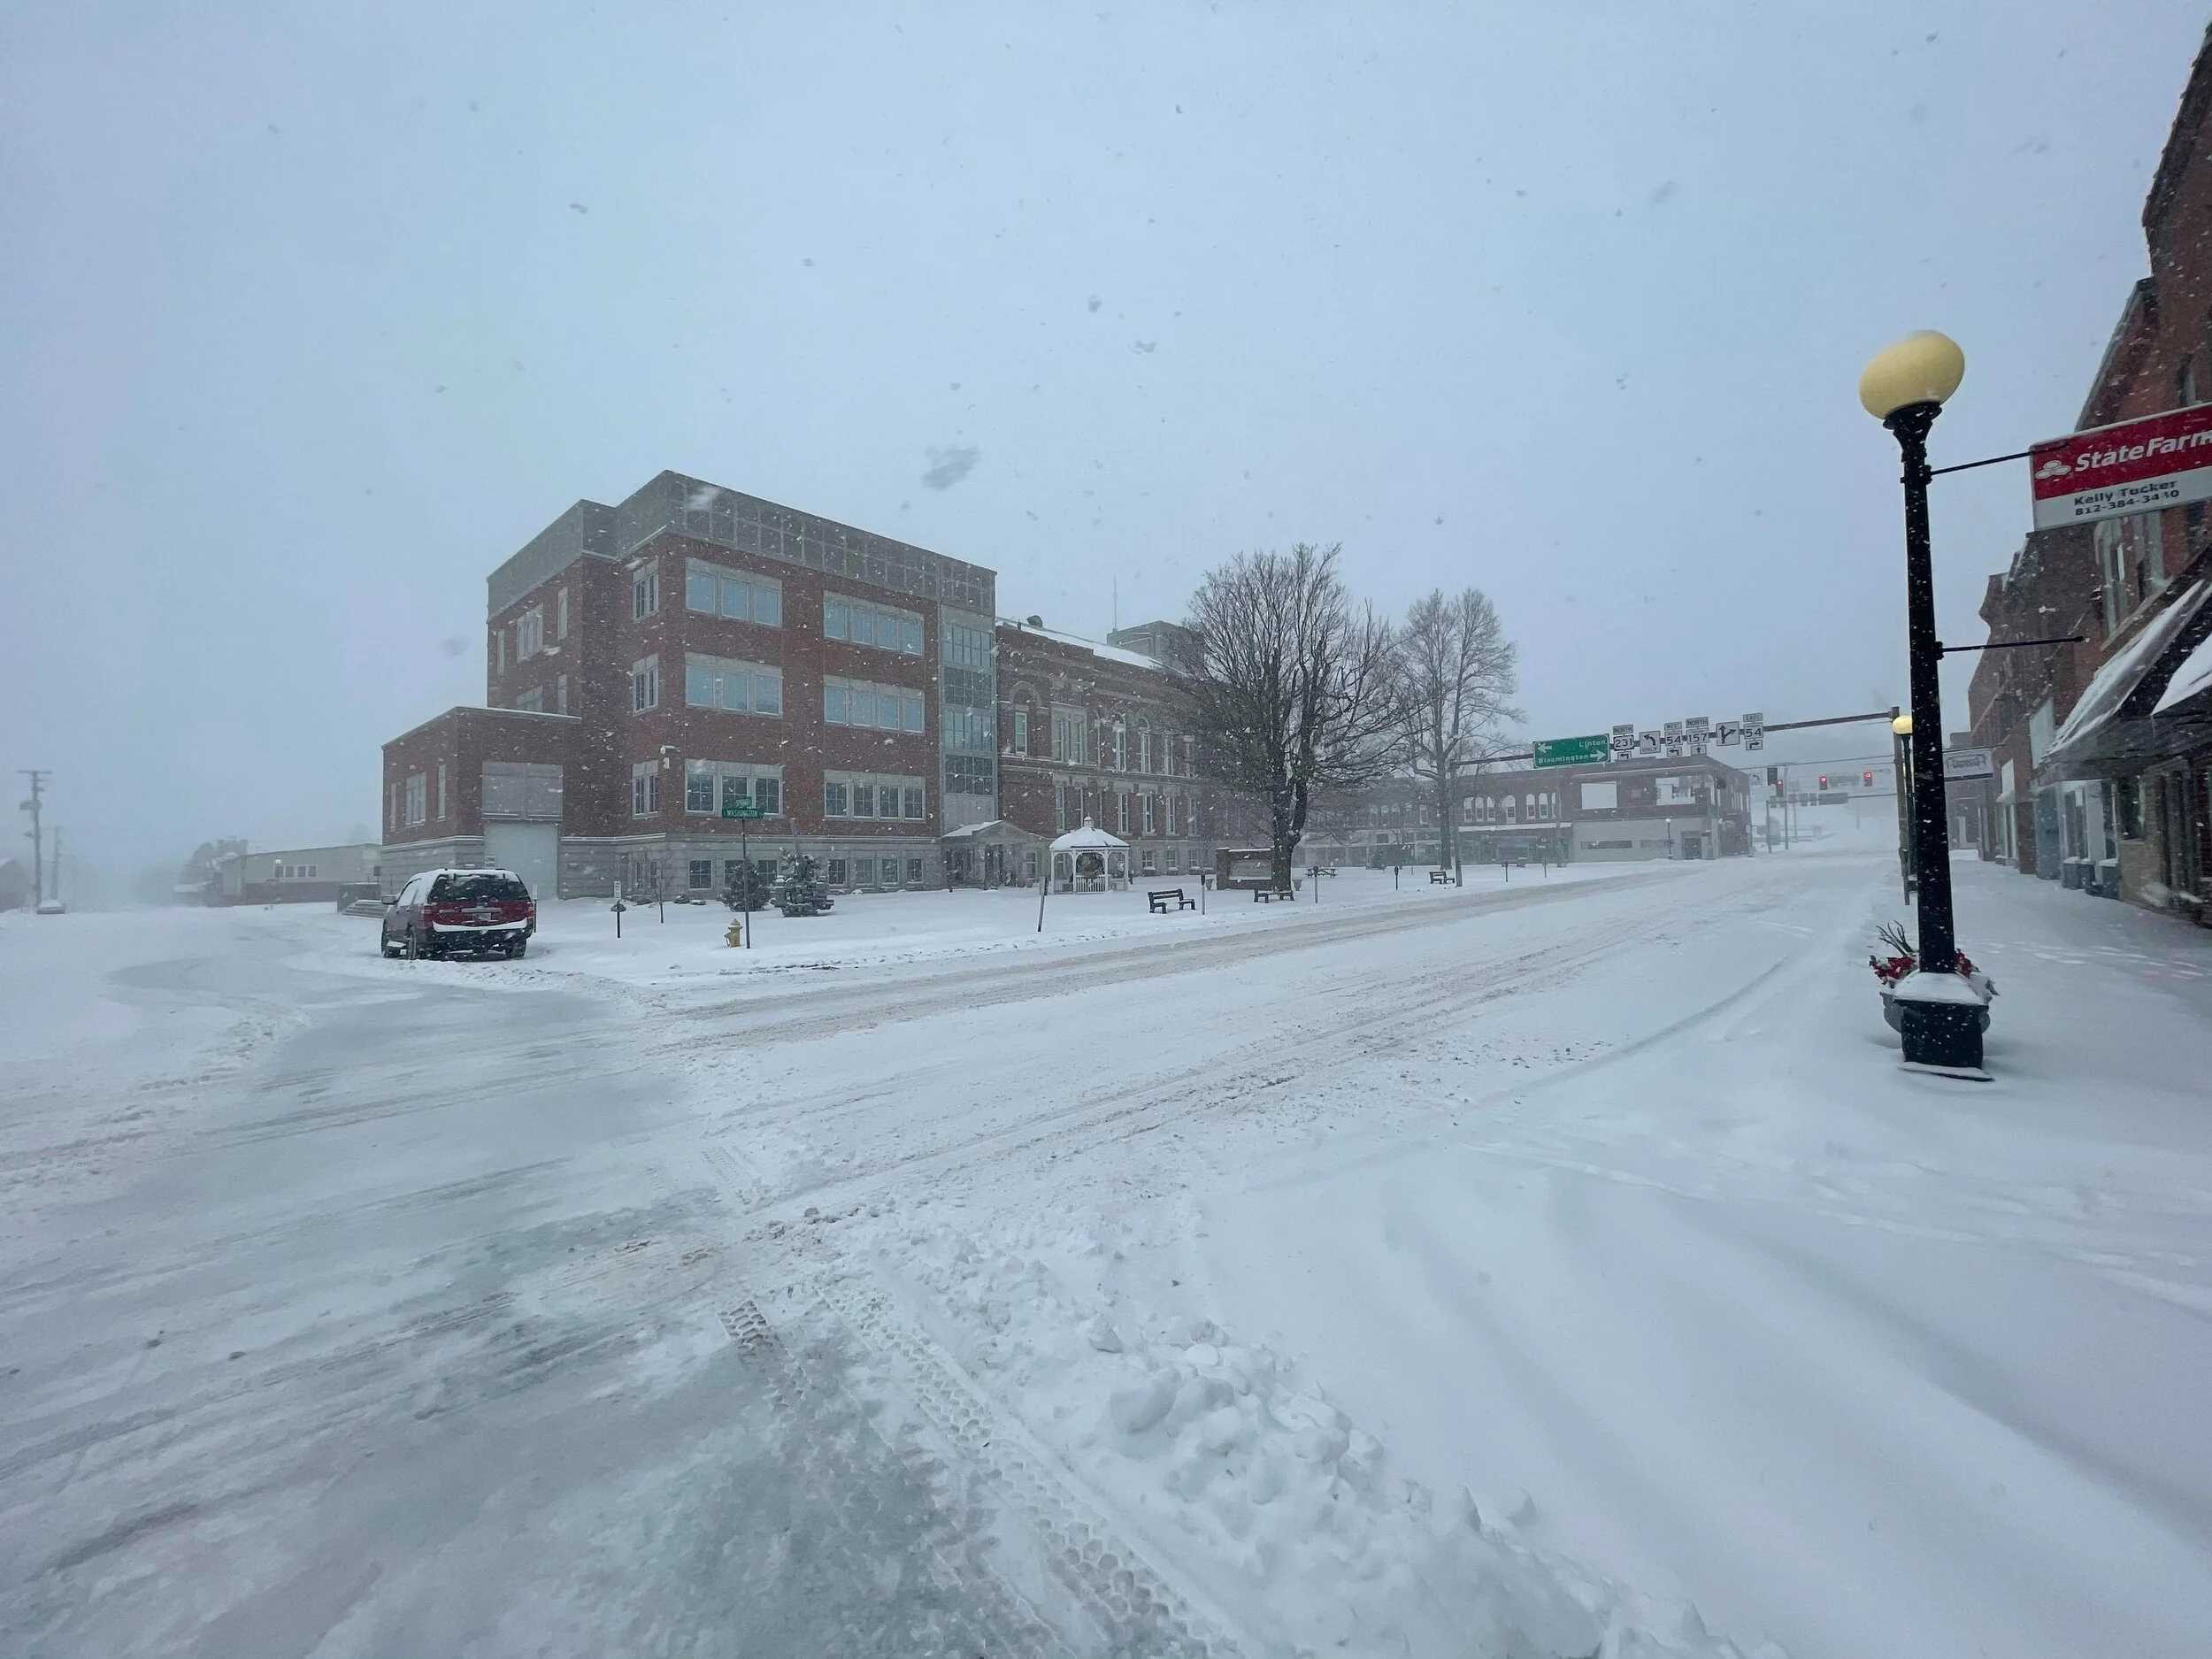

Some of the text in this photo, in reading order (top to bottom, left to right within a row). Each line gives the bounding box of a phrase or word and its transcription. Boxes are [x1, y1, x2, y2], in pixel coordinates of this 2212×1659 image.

[2074, 480, 2177, 505] Kelly Tucker
[1687, 718, 1708, 727] NORTH
[1688, 733, 1708, 743] 157
[1746, 728, 1762, 738] 54
[1579, 740, 1606, 749] Linton
[1615, 738, 1633, 747] 231
[1666, 735, 1681, 745] 54
[1538, 754, 1588, 764] Bloomington
